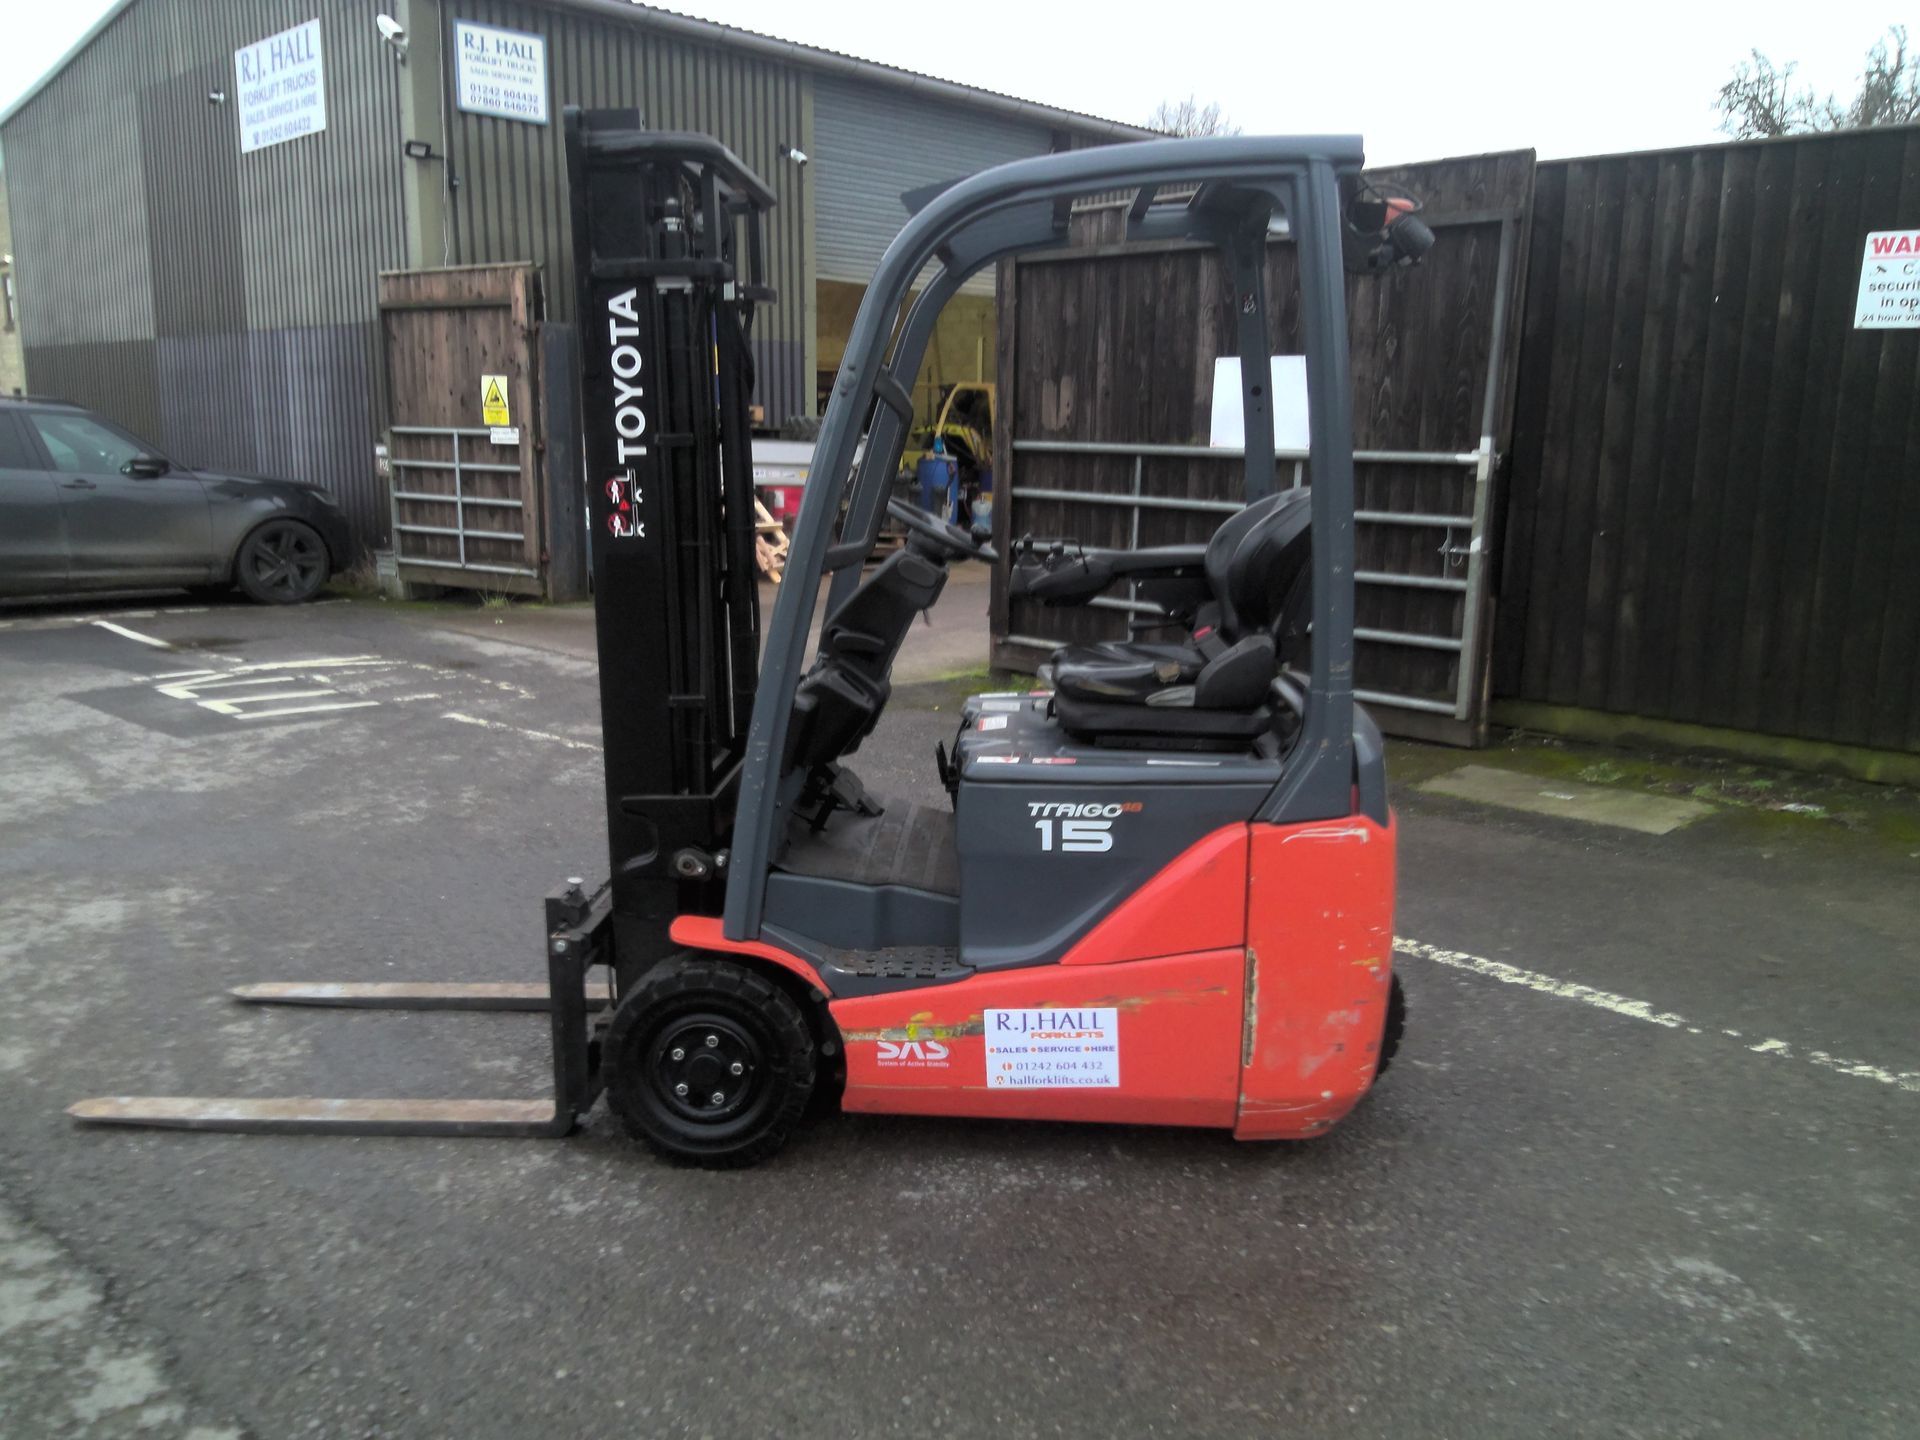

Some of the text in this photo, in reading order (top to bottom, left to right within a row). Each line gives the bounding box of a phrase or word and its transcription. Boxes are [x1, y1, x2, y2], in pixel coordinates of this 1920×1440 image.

[241, 28, 315, 85] R.J. HALL
[464, 32, 536, 62] R.J. HALL
[243, 69, 316, 107] FORKLIFT TRUCKS
[470, 83, 538, 103] 01242 604432
[261, 126, 282, 142] 01242
[1881, 295, 1894, 308] in
[608, 287, 647, 465] TOYOTA
[1027, 802, 1123, 818] TRAIGO
[1034, 819, 1113, 852] 15
[877, 1041, 950, 1060] SAS
[995, 1045, 1116, 1054] SALES SERVICE HIRE
[1016, 1061, 1104, 1071] 01242 604 432
[1009, 1075, 1112, 1085] hallforklifts.co.uk
